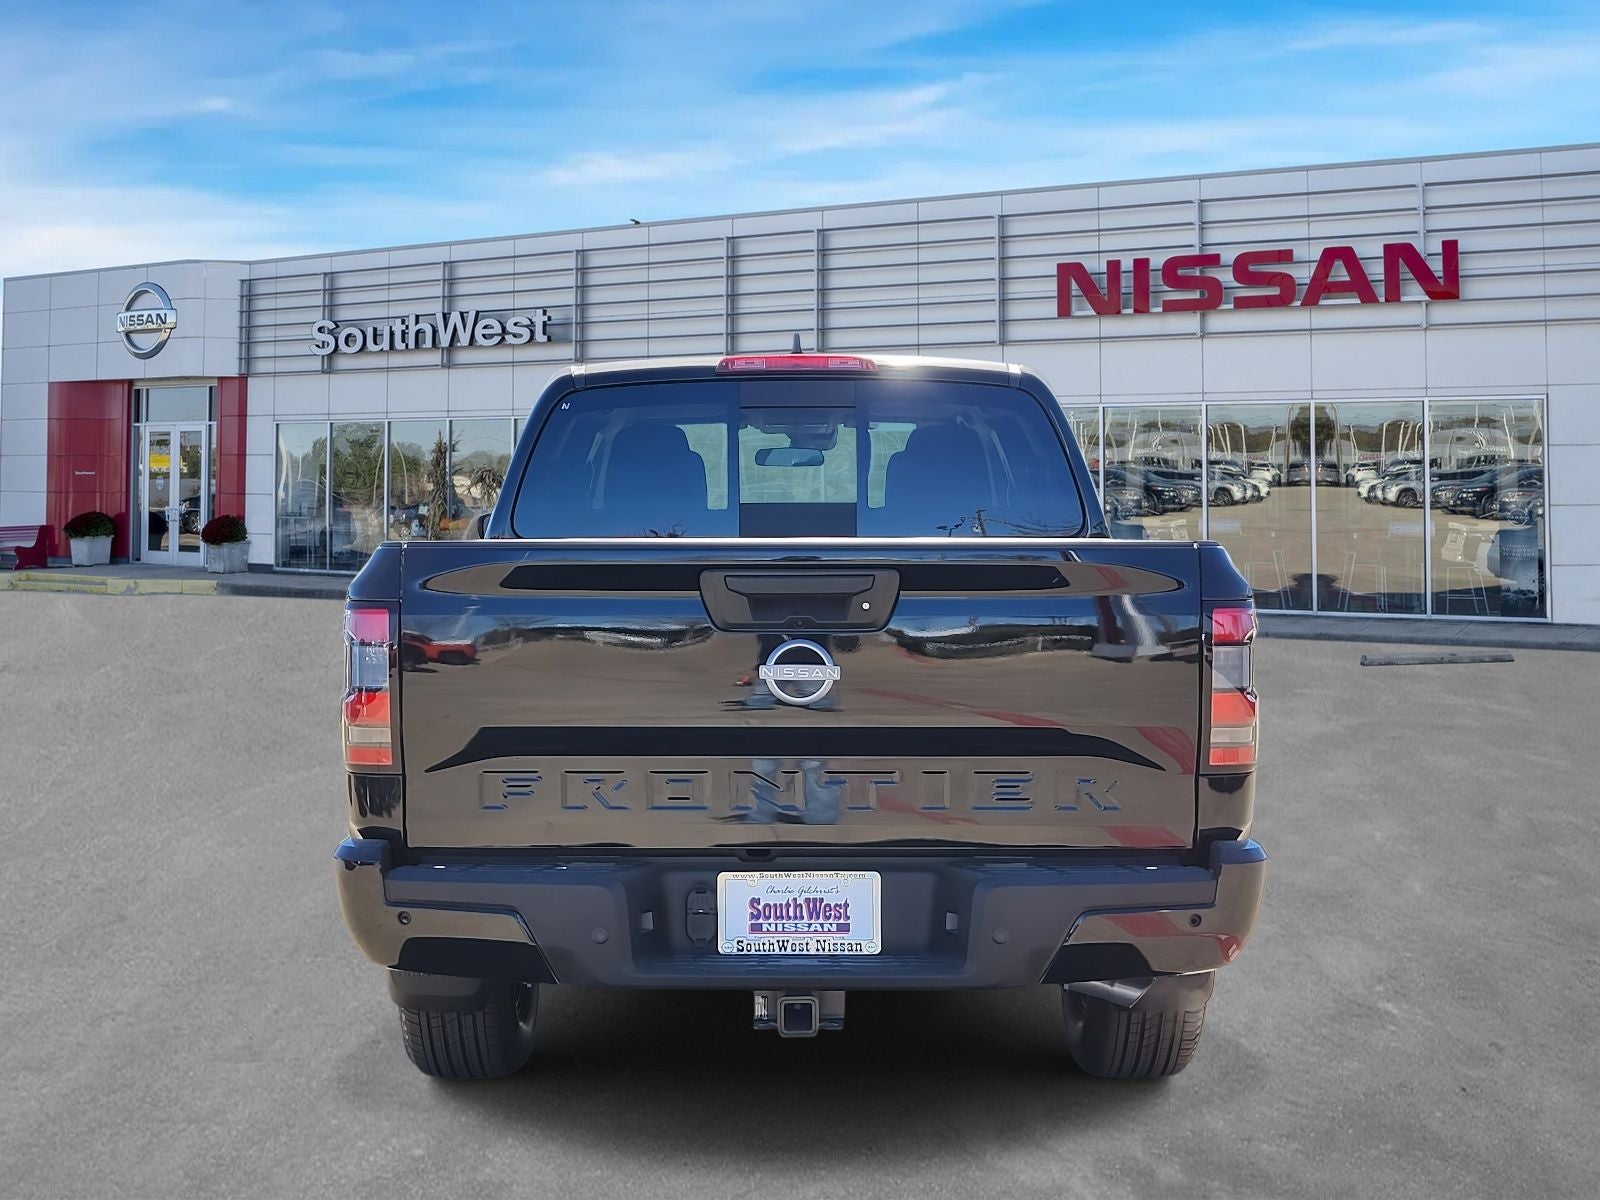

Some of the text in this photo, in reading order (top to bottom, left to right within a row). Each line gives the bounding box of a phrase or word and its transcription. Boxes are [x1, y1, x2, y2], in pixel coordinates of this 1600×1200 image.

[1056, 239, 1461, 318] NISSAN
[119, 312, 168, 328] NISSAN
[309, 308, 551, 356] SouthWest
[761, 667, 838, 678] NISSAN
[478, 769, 1122, 811] FRONTIER
[765, 884, 841, 897] Charlie Gilchrist's
[748, 896, 851, 922] SouthWest
[761, 922, 837, 932] NISSAN
[736, 939, 863, 953] SouthWest Nissan
